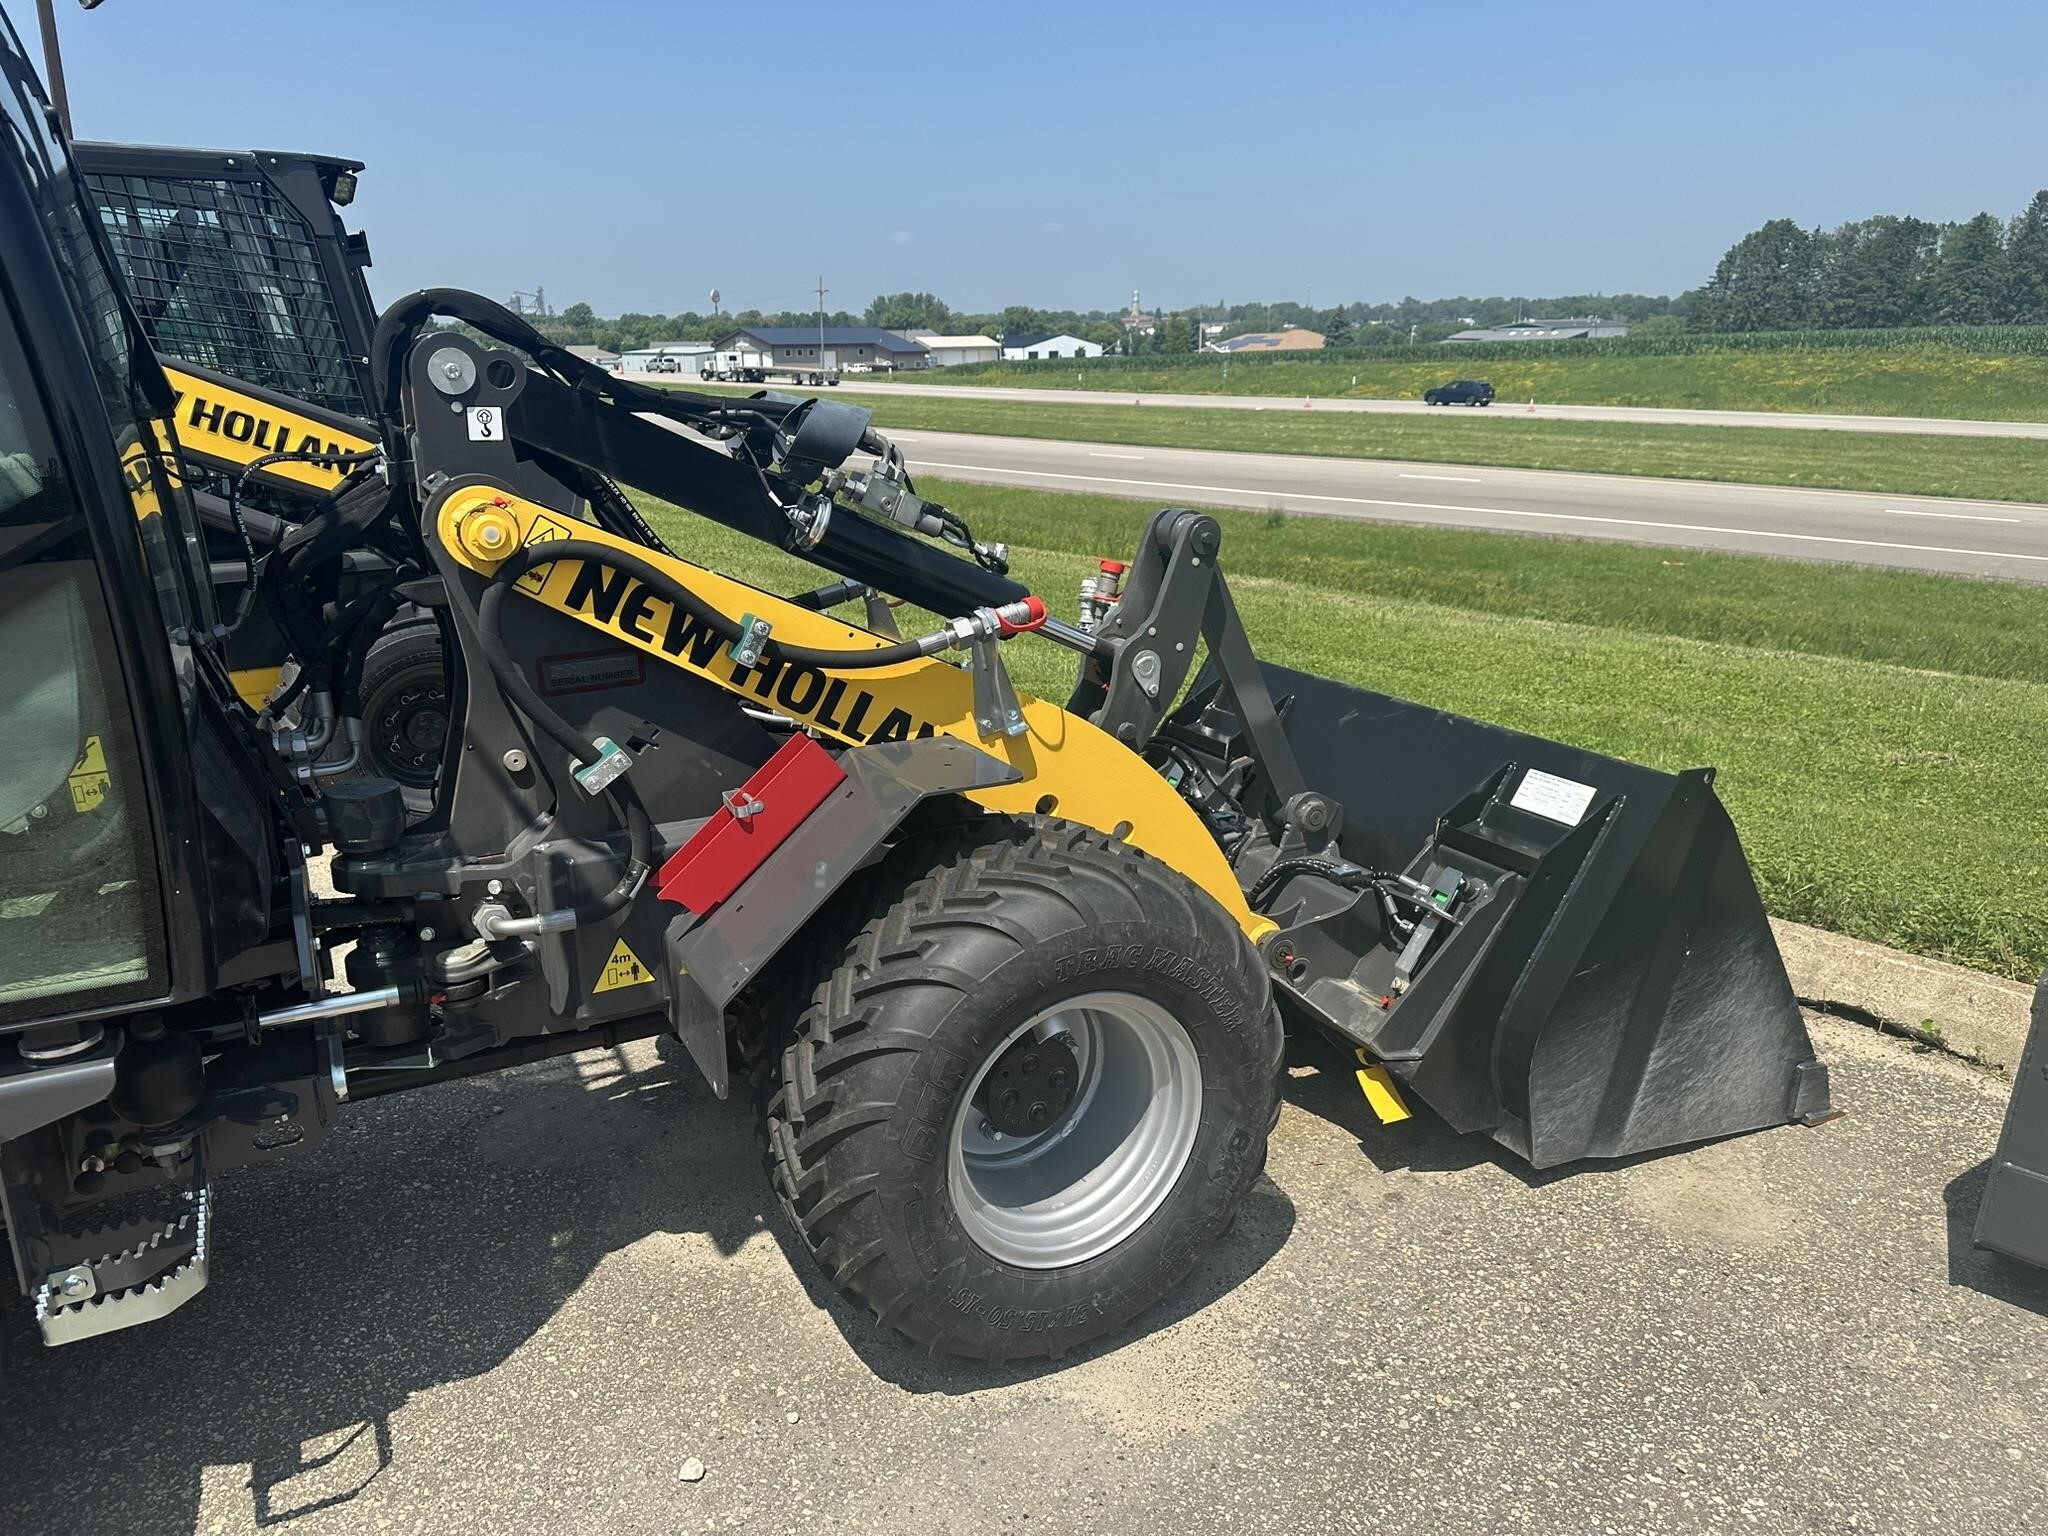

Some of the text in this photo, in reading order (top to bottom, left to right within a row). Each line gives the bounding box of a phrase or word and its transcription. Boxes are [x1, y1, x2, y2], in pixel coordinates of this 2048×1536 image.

[188, 397, 356, 476] HOLLAN
[564, 559, 728, 669] NEW
[551, 668, 634, 687] SERIAL NUMBER
[612, 954, 631, 964] 4m
[1055, 944, 1245, 1033] TRAC MASTER
